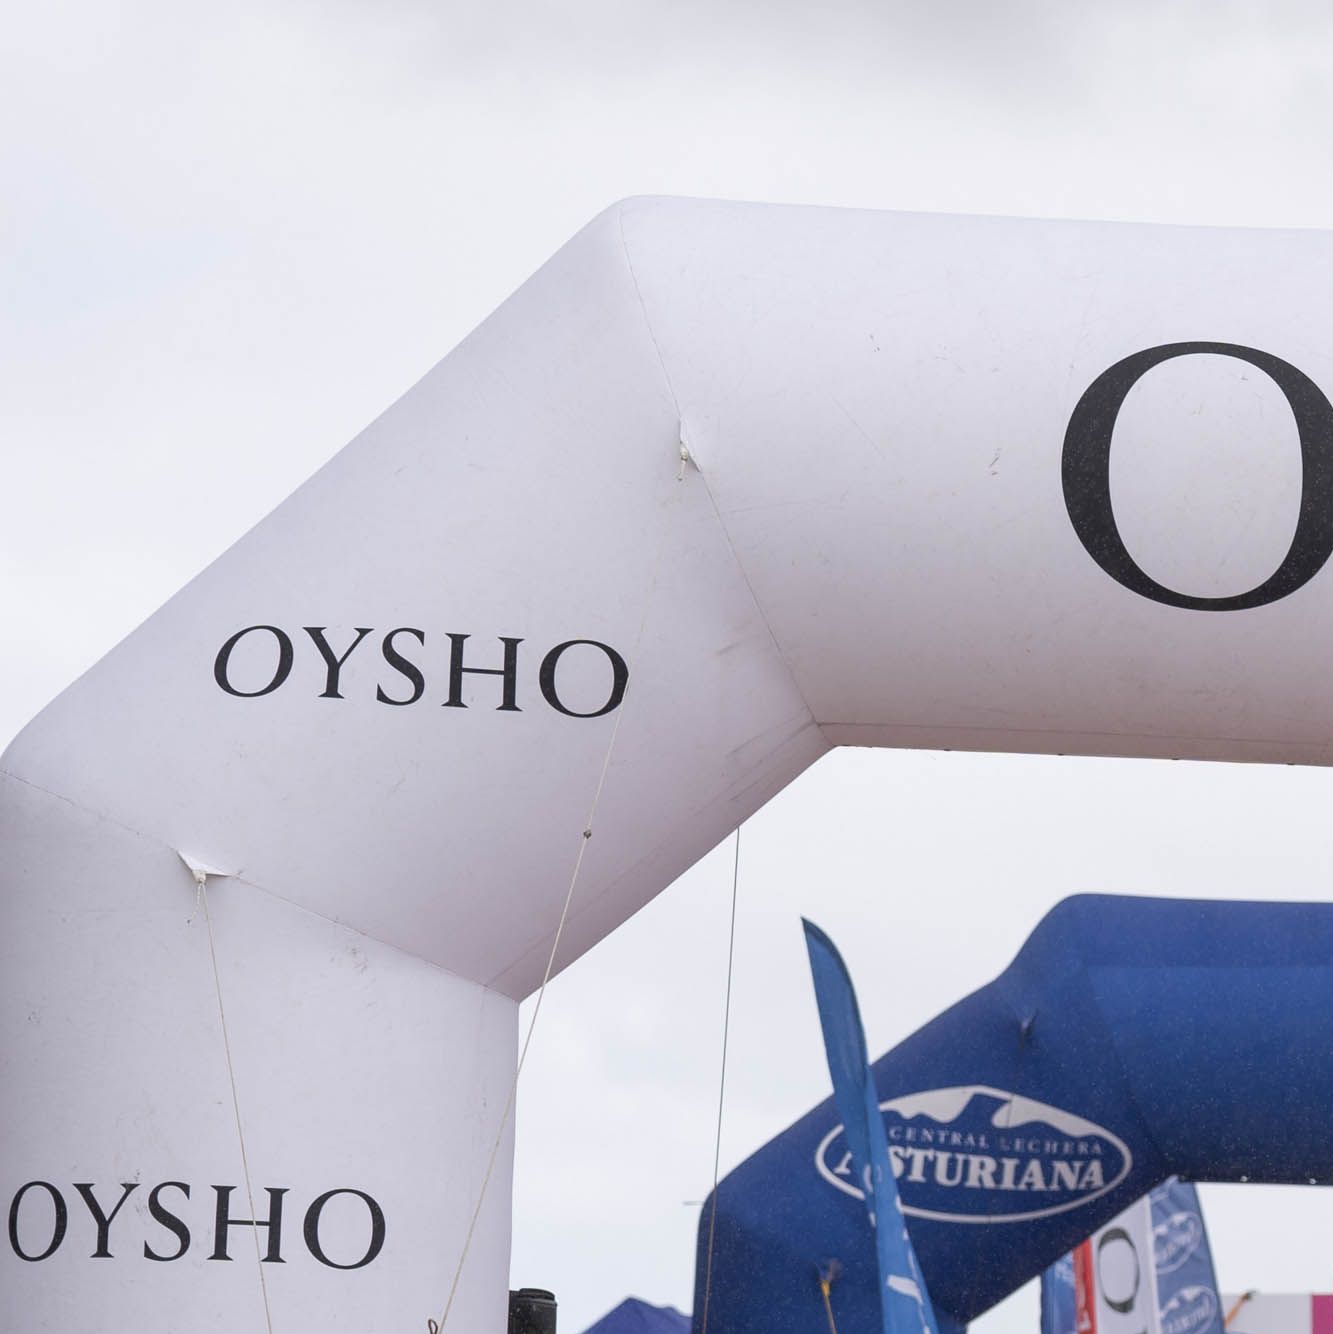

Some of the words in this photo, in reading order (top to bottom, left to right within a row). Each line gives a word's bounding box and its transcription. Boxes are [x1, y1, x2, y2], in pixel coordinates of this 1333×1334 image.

[213, 625, 629, 718] OYSHO
[888, 1125, 990, 1150] CENTRAL
[999, 1138, 1104, 1156] LECHERA
[8, 1181, 386, 1270] OYSHO
